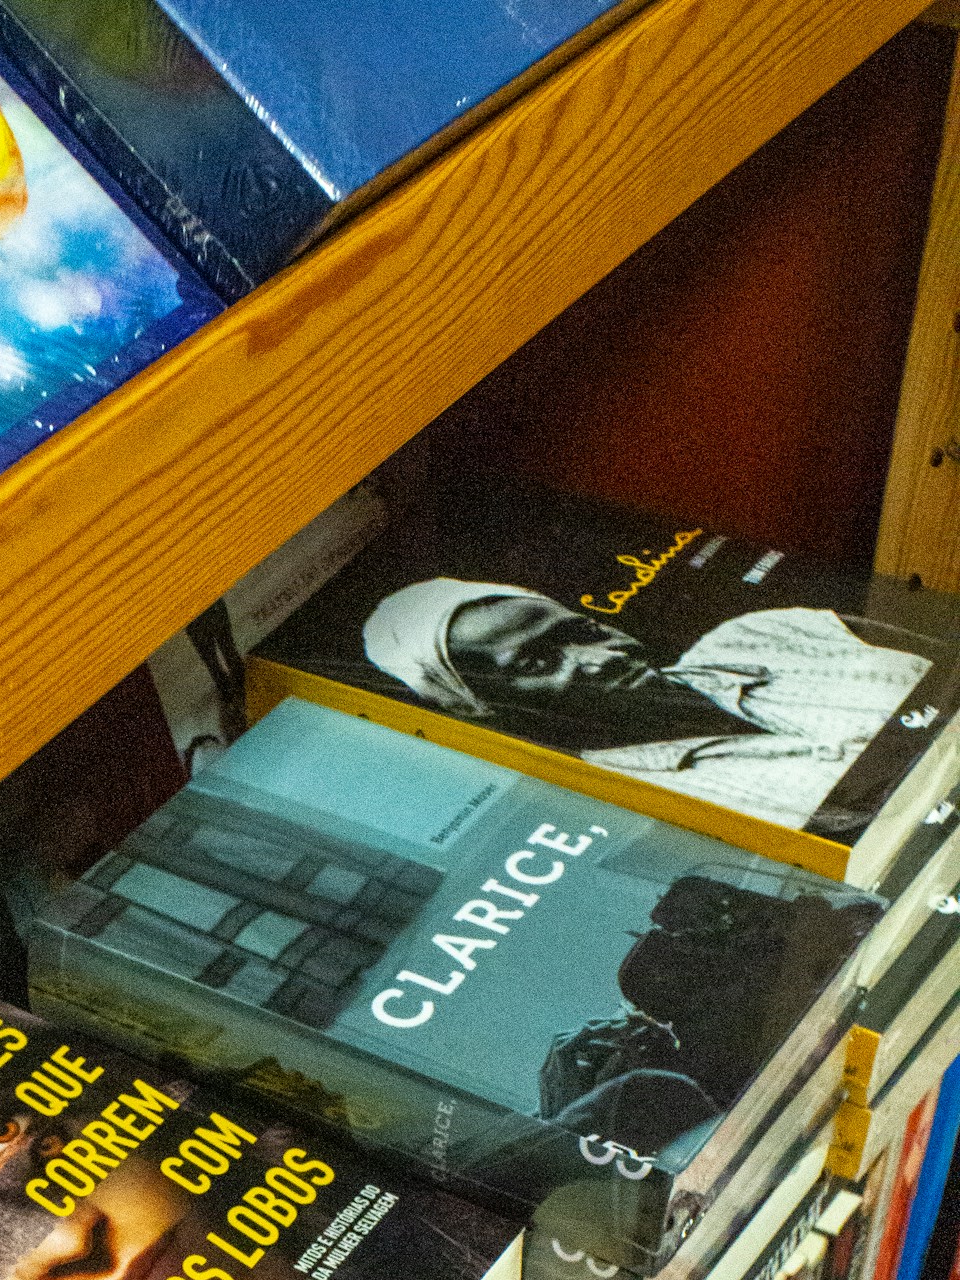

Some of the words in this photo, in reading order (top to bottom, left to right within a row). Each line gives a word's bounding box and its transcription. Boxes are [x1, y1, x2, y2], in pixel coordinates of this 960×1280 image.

[371, 822, 609, 1030] CLARICE,
[14, 1045, 104, 1118] QUE
[25, 1079, 180, 1218] CORREM
[160, 1111, 257, 1195] COM
[207, 1147, 335, 1269] LOBOS
[322, 1231, 364, 1270] MULHER
[353, 1191, 400, 1236] SELVAGEM
[323, 1194, 370, 1243] HISTÓRIAS
[360, 1184, 381, 1204] DO
[293, 1242, 327, 1274] MITOS
[317, 1235, 333, 1248] E
